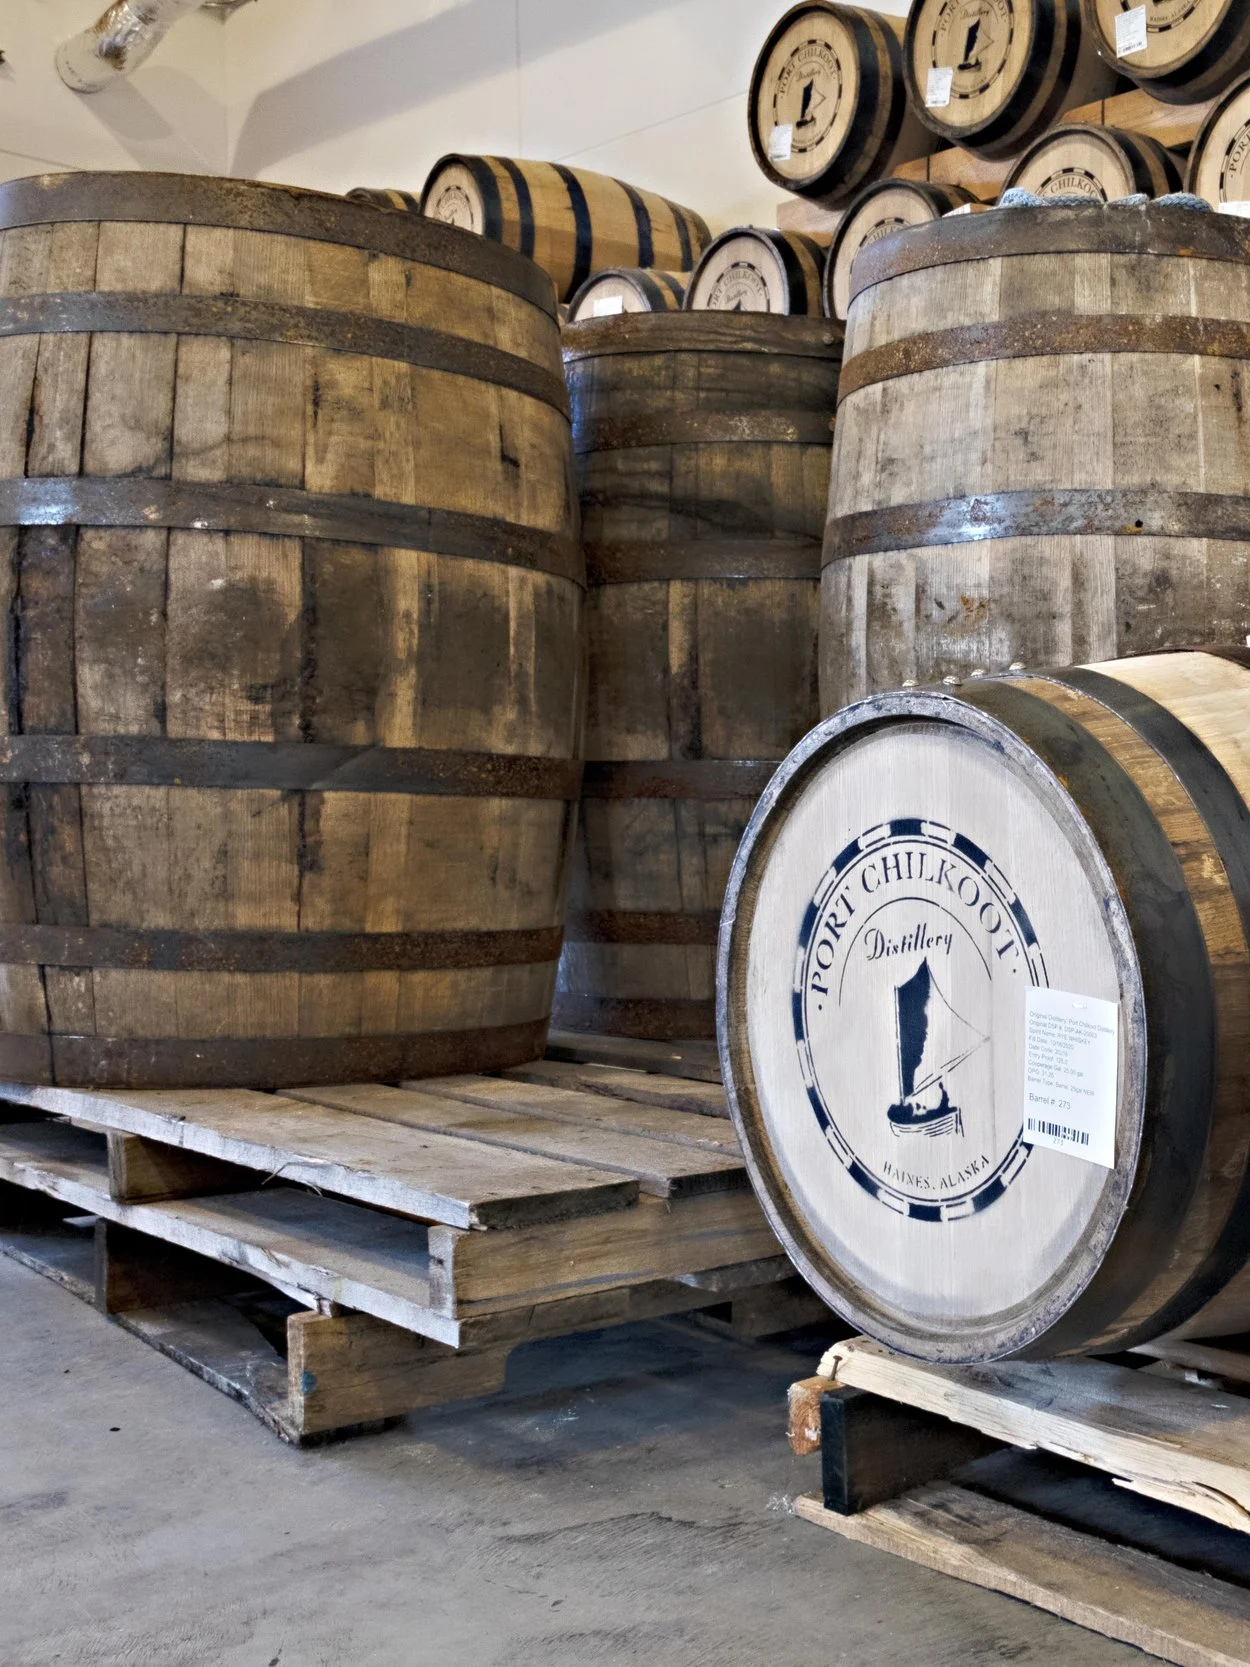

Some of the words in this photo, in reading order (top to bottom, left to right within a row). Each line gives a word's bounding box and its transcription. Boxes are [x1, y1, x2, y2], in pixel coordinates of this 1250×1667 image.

[1050, 177, 1098, 197] CHILKOO
[811, 886, 856, 996] PORT
[861, 851, 1019, 961] CHILKOOT
[864, 923, 953, 961] Distillery
[1029, 1092, 1050, 1105] Barrel
[1058, 1100, 1071, 1110] 273
[1053, 1137, 1064, 1146] 273
[940, 1155, 989, 1190] ALASKA
